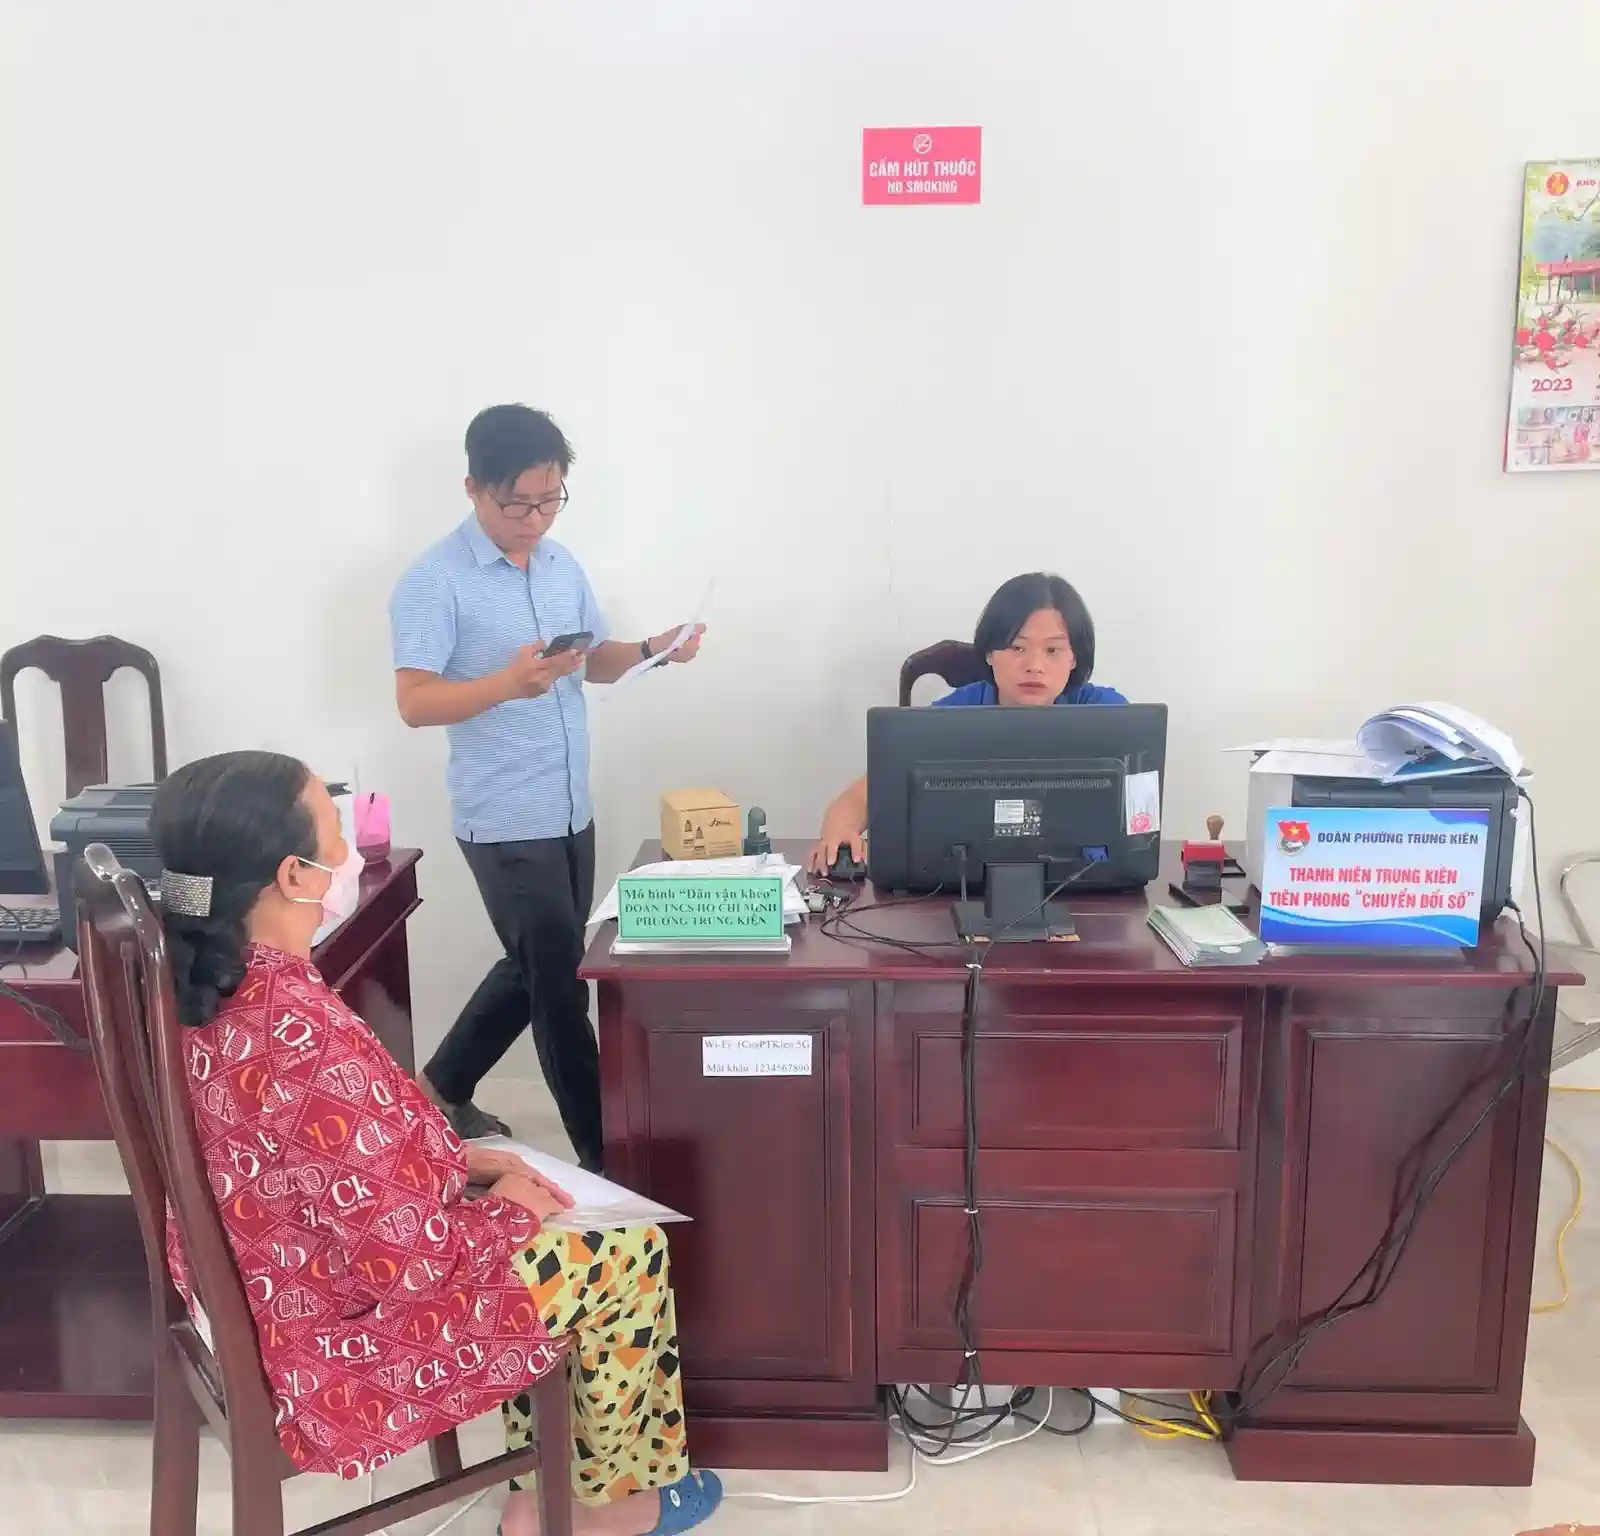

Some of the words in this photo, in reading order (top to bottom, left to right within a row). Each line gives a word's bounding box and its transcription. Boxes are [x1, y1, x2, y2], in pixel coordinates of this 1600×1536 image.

[869, 156, 899, 177] CẤM
[903, 158, 930, 177] HÚT
[934, 155, 976, 177] THUỐC
[887, 180, 903, 193] NO
[906, 179, 958, 193] SMOKING
[1531, 378, 1572, 393] 2023
[1408, 832, 1446, 845] TRUNG
[1290, 867, 1334, 883] THANH
[1339, 865, 1372, 884] NIÊN
[1376, 867, 1420, 884] TRUNG
[1304, 891, 1350, 908] PHONG
[331, 1174, 374, 1209] Ck
[341, 1333, 379, 1359] Ck
[414, 1359, 449, 1389] Ck
